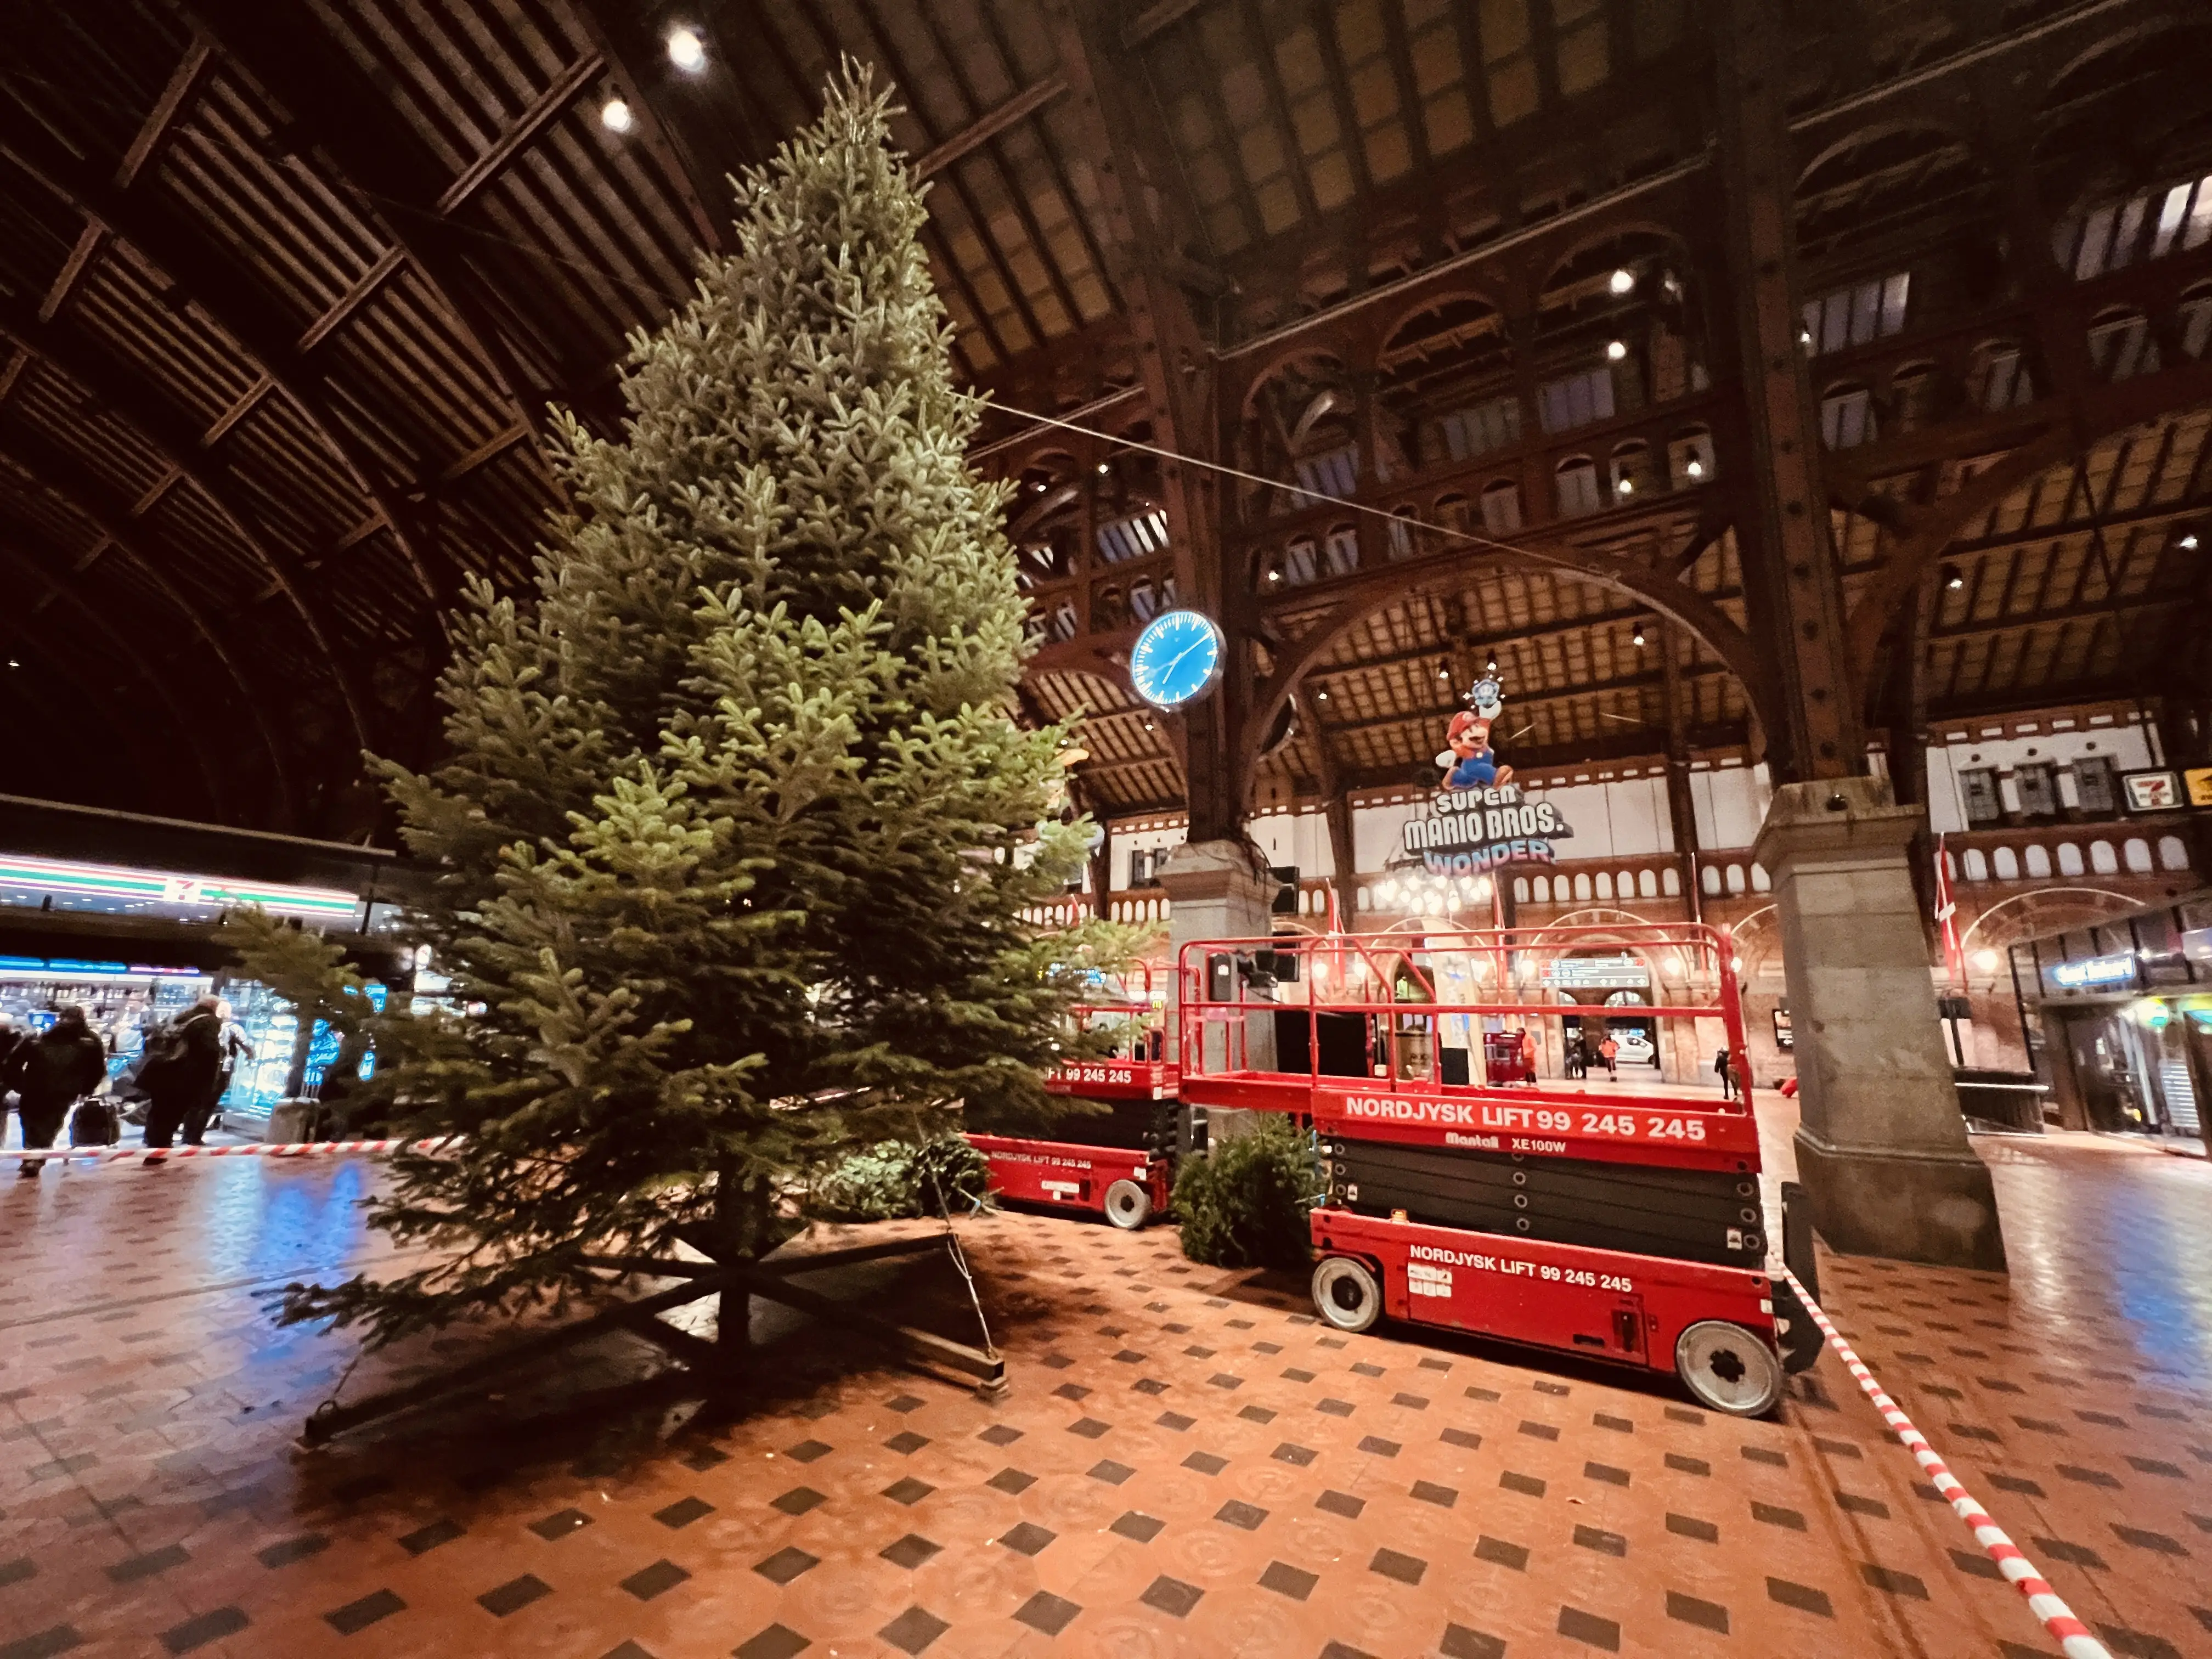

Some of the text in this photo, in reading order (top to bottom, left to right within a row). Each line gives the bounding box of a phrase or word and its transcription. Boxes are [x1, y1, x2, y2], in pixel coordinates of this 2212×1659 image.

[1436, 785, 1517, 813] SUPER
[1404, 802, 1564, 850] MARIO BROS.
[1423, 838, 1553, 877] WONDER
[1066, 1068, 1081, 1081] 99
[1084, 1068, 1105, 1082] 245
[1108, 1069, 1132, 1084] 245
[1346, 1096, 1706, 1141] NORDJYSK LIFT 99 245 245
[1511, 1137, 1566, 1153] XE100W
[1062, 1158, 1076, 1167] 245
[1077, 1159, 1092, 1169] 245
[1409, 1244, 1633, 1293] NORDJYSK LIFT 99 245 245
